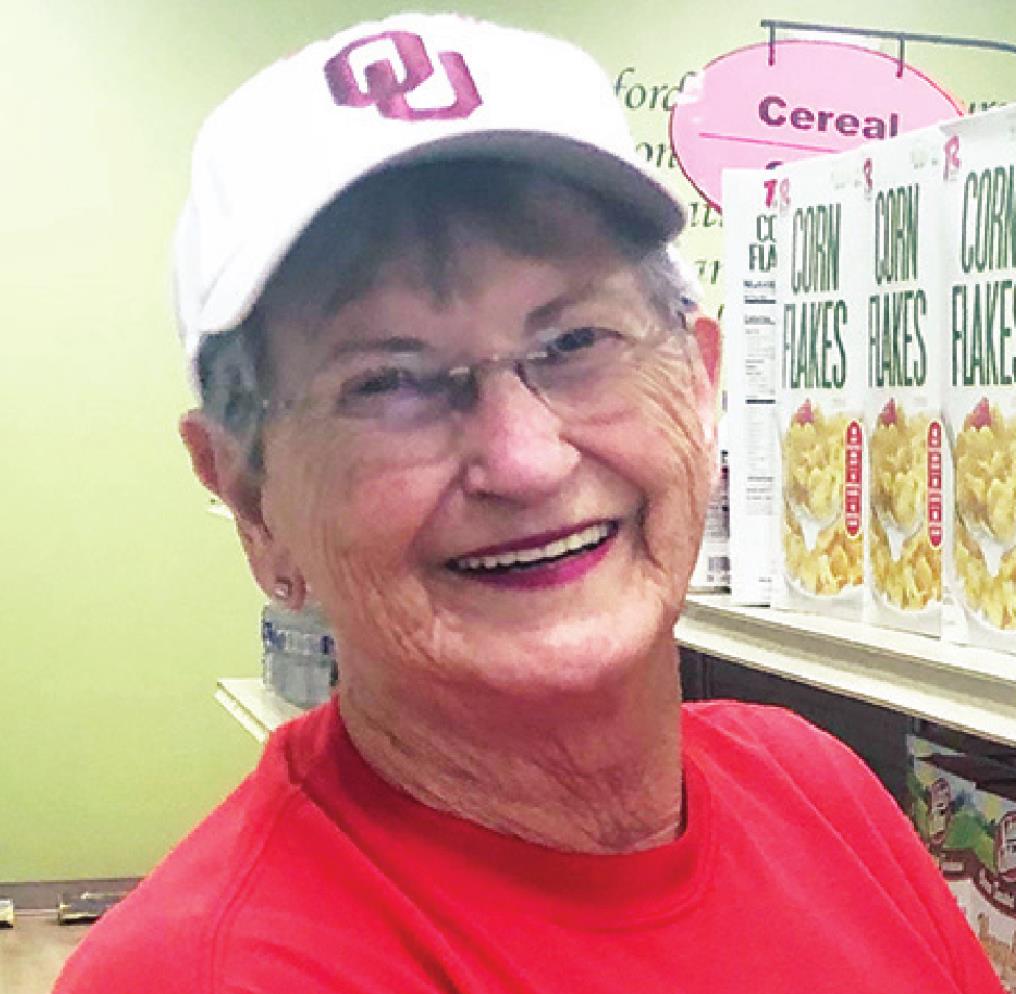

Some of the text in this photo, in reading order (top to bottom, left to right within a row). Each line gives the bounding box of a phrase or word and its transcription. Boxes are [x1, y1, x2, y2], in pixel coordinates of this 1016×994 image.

[324, 31, 482, 120] OU
[758, 96, 899, 139] Cereal
[791, 203, 841, 294] CORN
[875, 183, 919, 285] CORN
[783, 300, 848, 389] FLAKES
[868, 290, 927, 388] FLAKES
